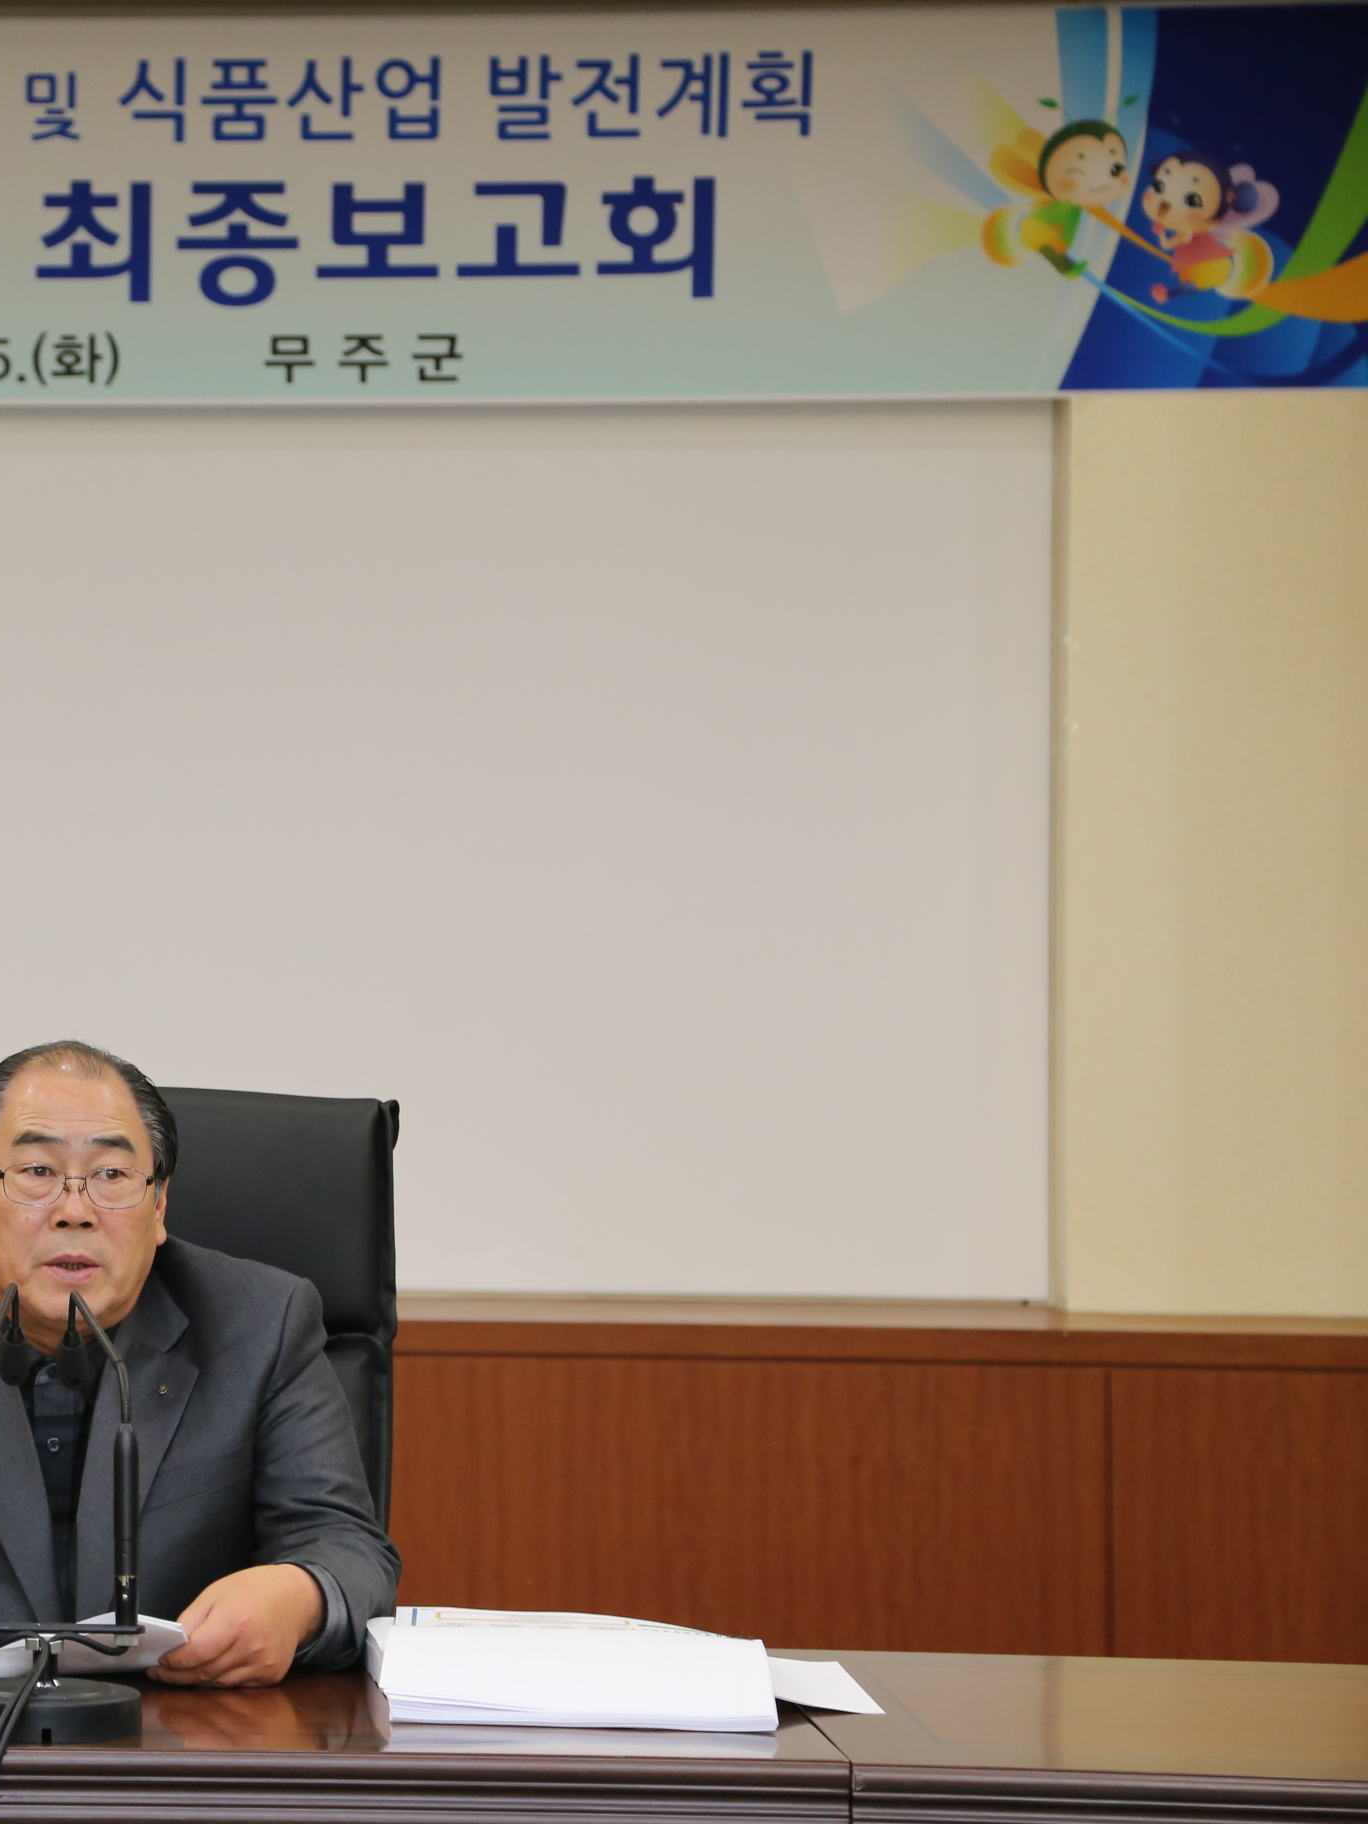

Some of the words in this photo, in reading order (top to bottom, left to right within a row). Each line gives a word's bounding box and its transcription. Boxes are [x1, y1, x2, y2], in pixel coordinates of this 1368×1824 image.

[24, 70, 81, 141] 및
[118, 54, 443, 143] 식품산업
[488, 48, 815, 141] 발전계획
[35, 175, 717, 308] 최종보고회
